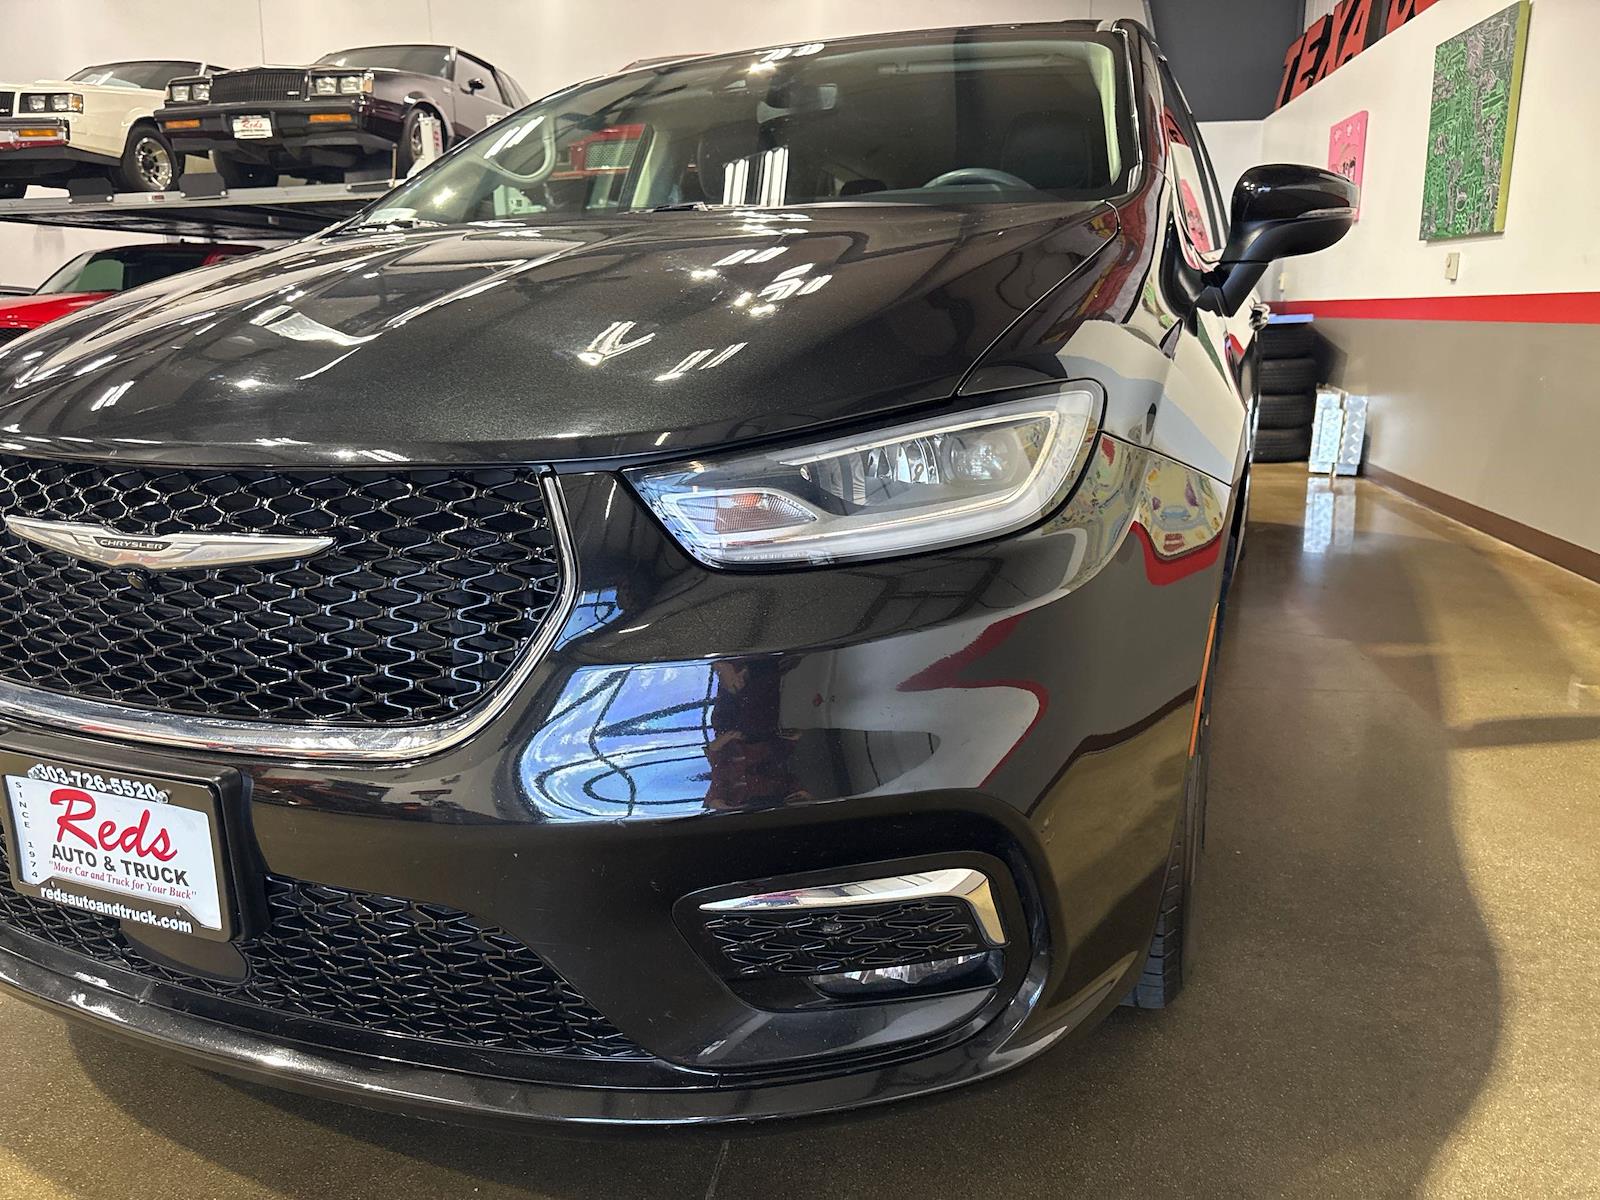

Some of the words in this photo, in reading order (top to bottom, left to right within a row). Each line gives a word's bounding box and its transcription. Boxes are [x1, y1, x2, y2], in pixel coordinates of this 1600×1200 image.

[99, 538, 164, 550] CHRYSLER
[37, 763, 158, 801] 303-726-5520
[15, 781, 31, 829] SINCE
[27, 841, 39, 879] 1974
[50, 788, 179, 862] Reds
[51, 843, 98, 868] AUTO
[103, 855, 117, 873] &
[120, 858, 190, 887] TRUCK
[74, 865, 89, 878] Car
[90, 871, 105, 882] and
[106, 873, 130, 888] Truck
[131, 878, 144, 890] for
[146, 881, 167, 895] Your
[40, 886, 193, 934] redsautoandtruck.com
